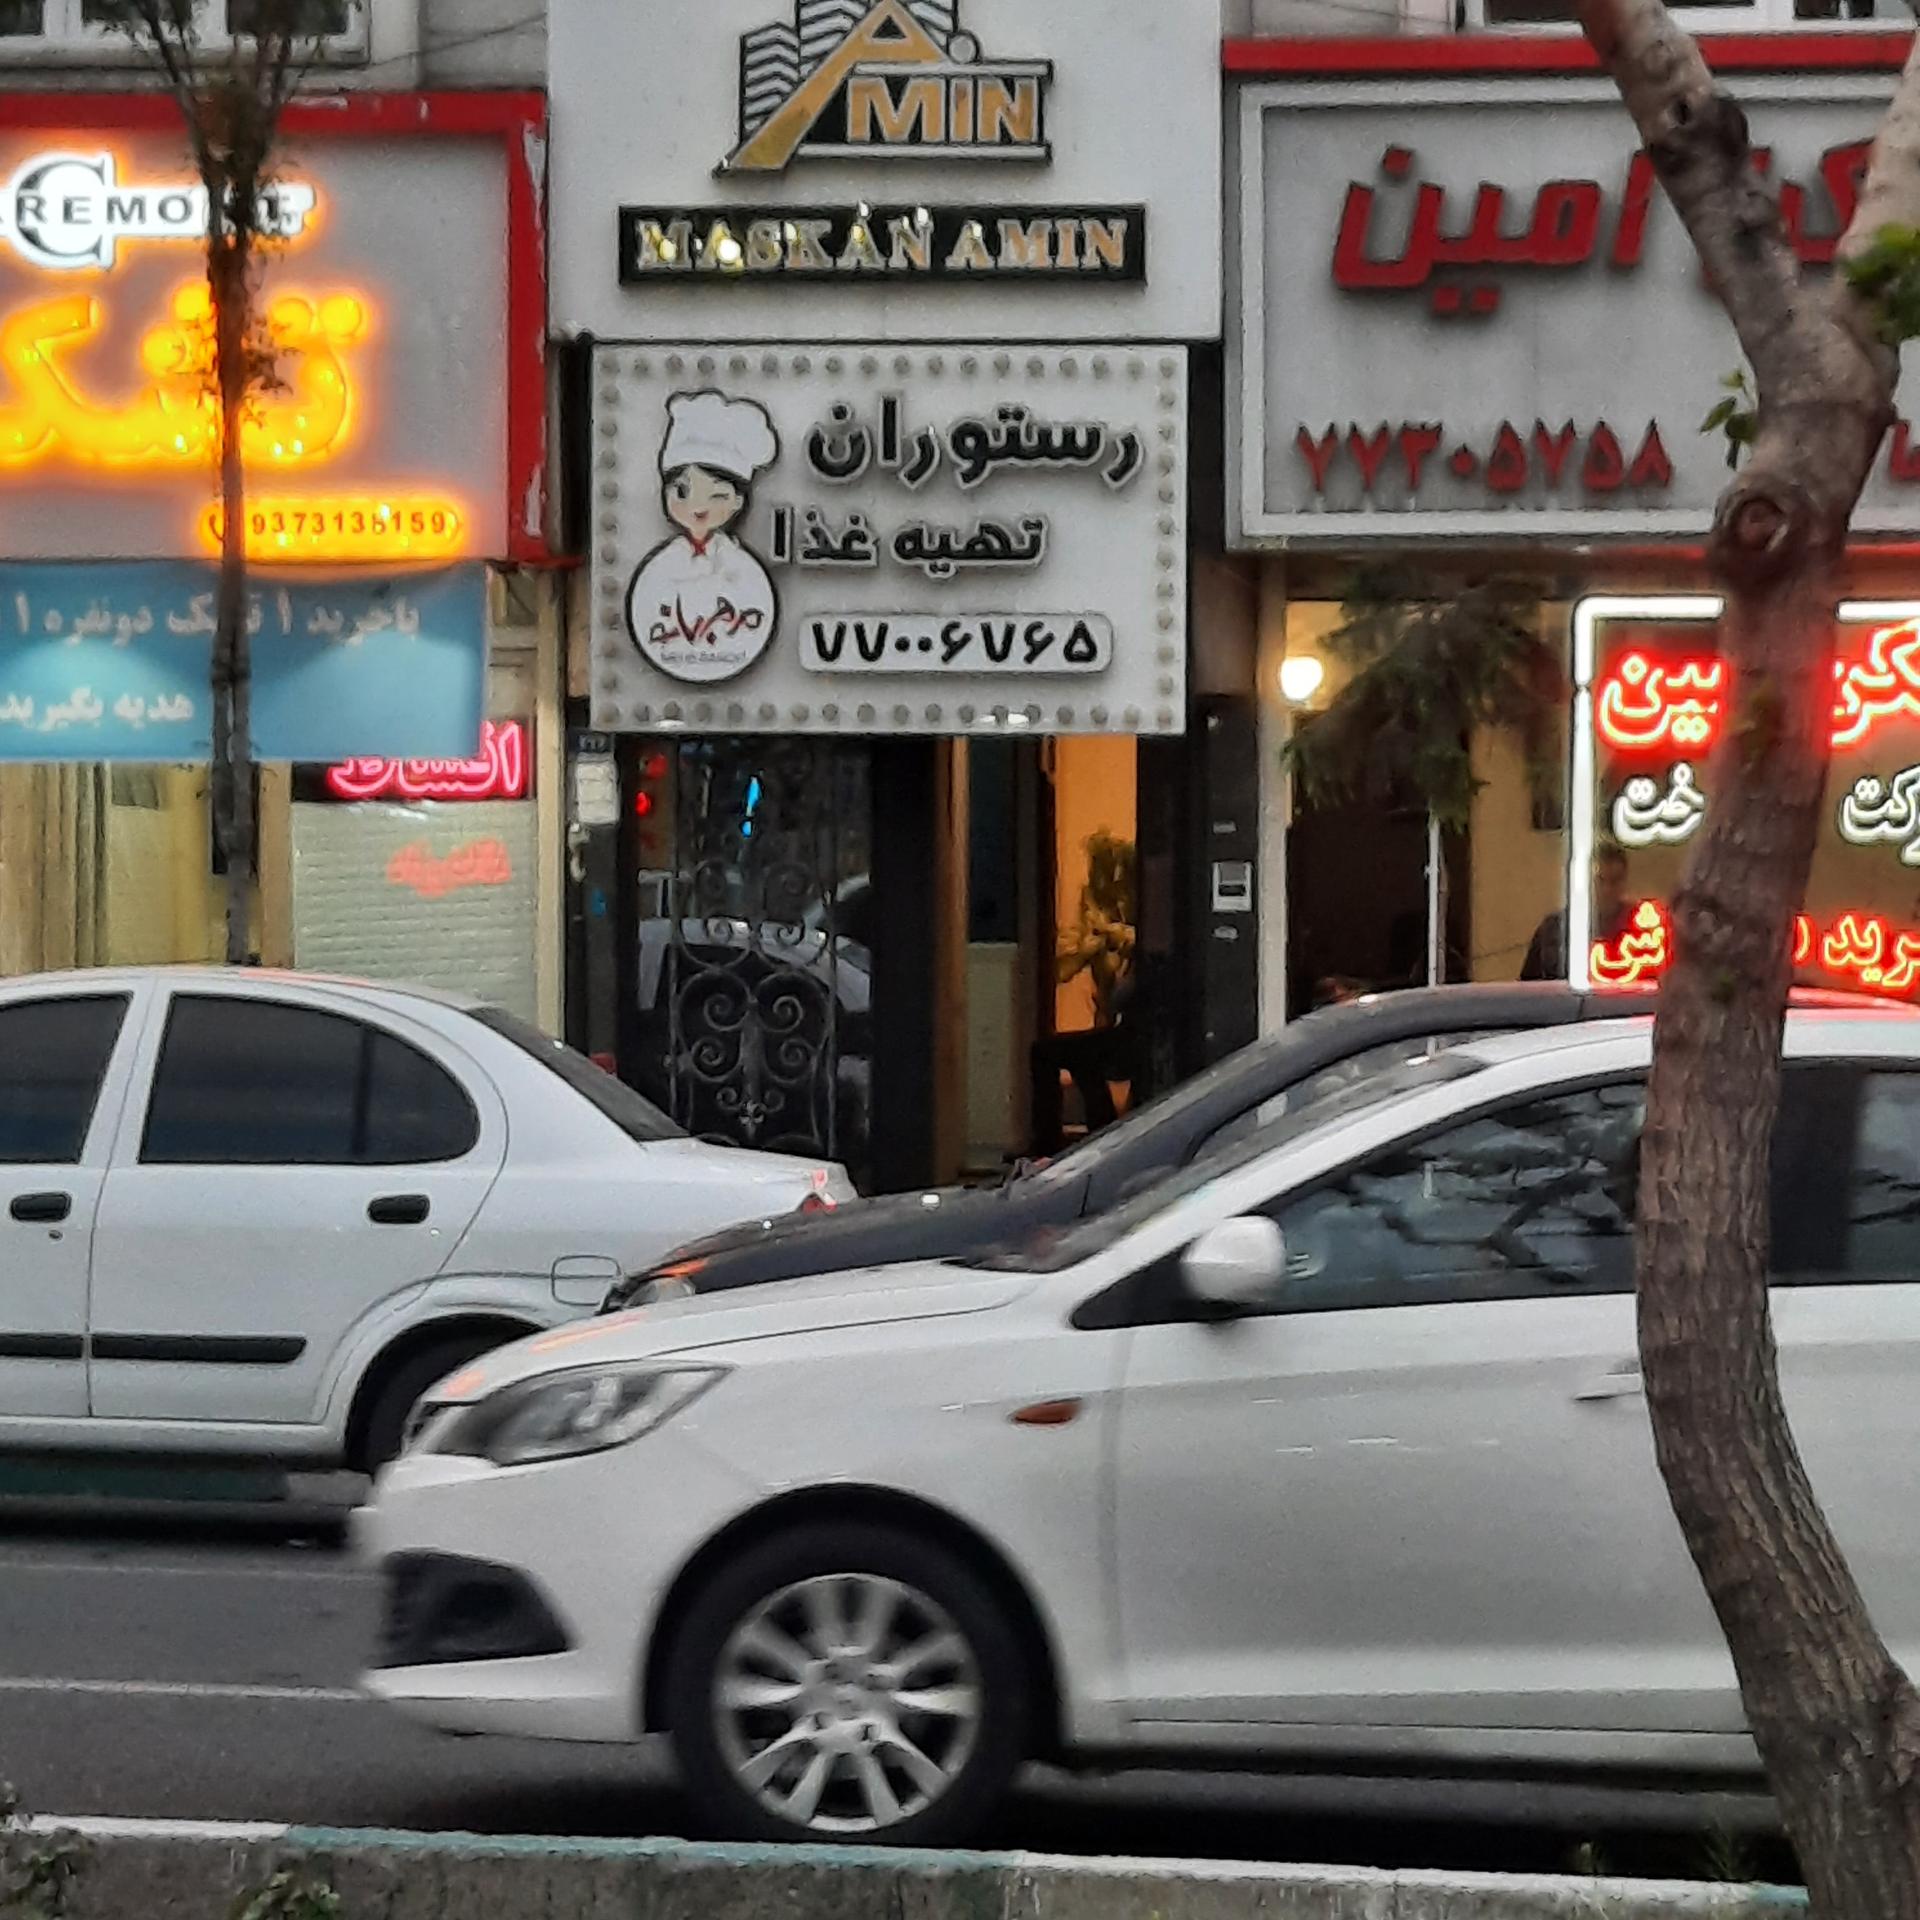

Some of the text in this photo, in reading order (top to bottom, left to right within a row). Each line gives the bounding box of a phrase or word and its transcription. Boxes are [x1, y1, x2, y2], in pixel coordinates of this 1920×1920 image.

[635, 216, 1128, 272] MASKAN AMIN
[1332, 144, 1656, 314] امین
[807, 393, 1144, 490] رستوران
[769, 504, 1048, 578] تهیه غذا
[811, 619, 1099, 664] ۷۷۰۰۶۷۶۵
